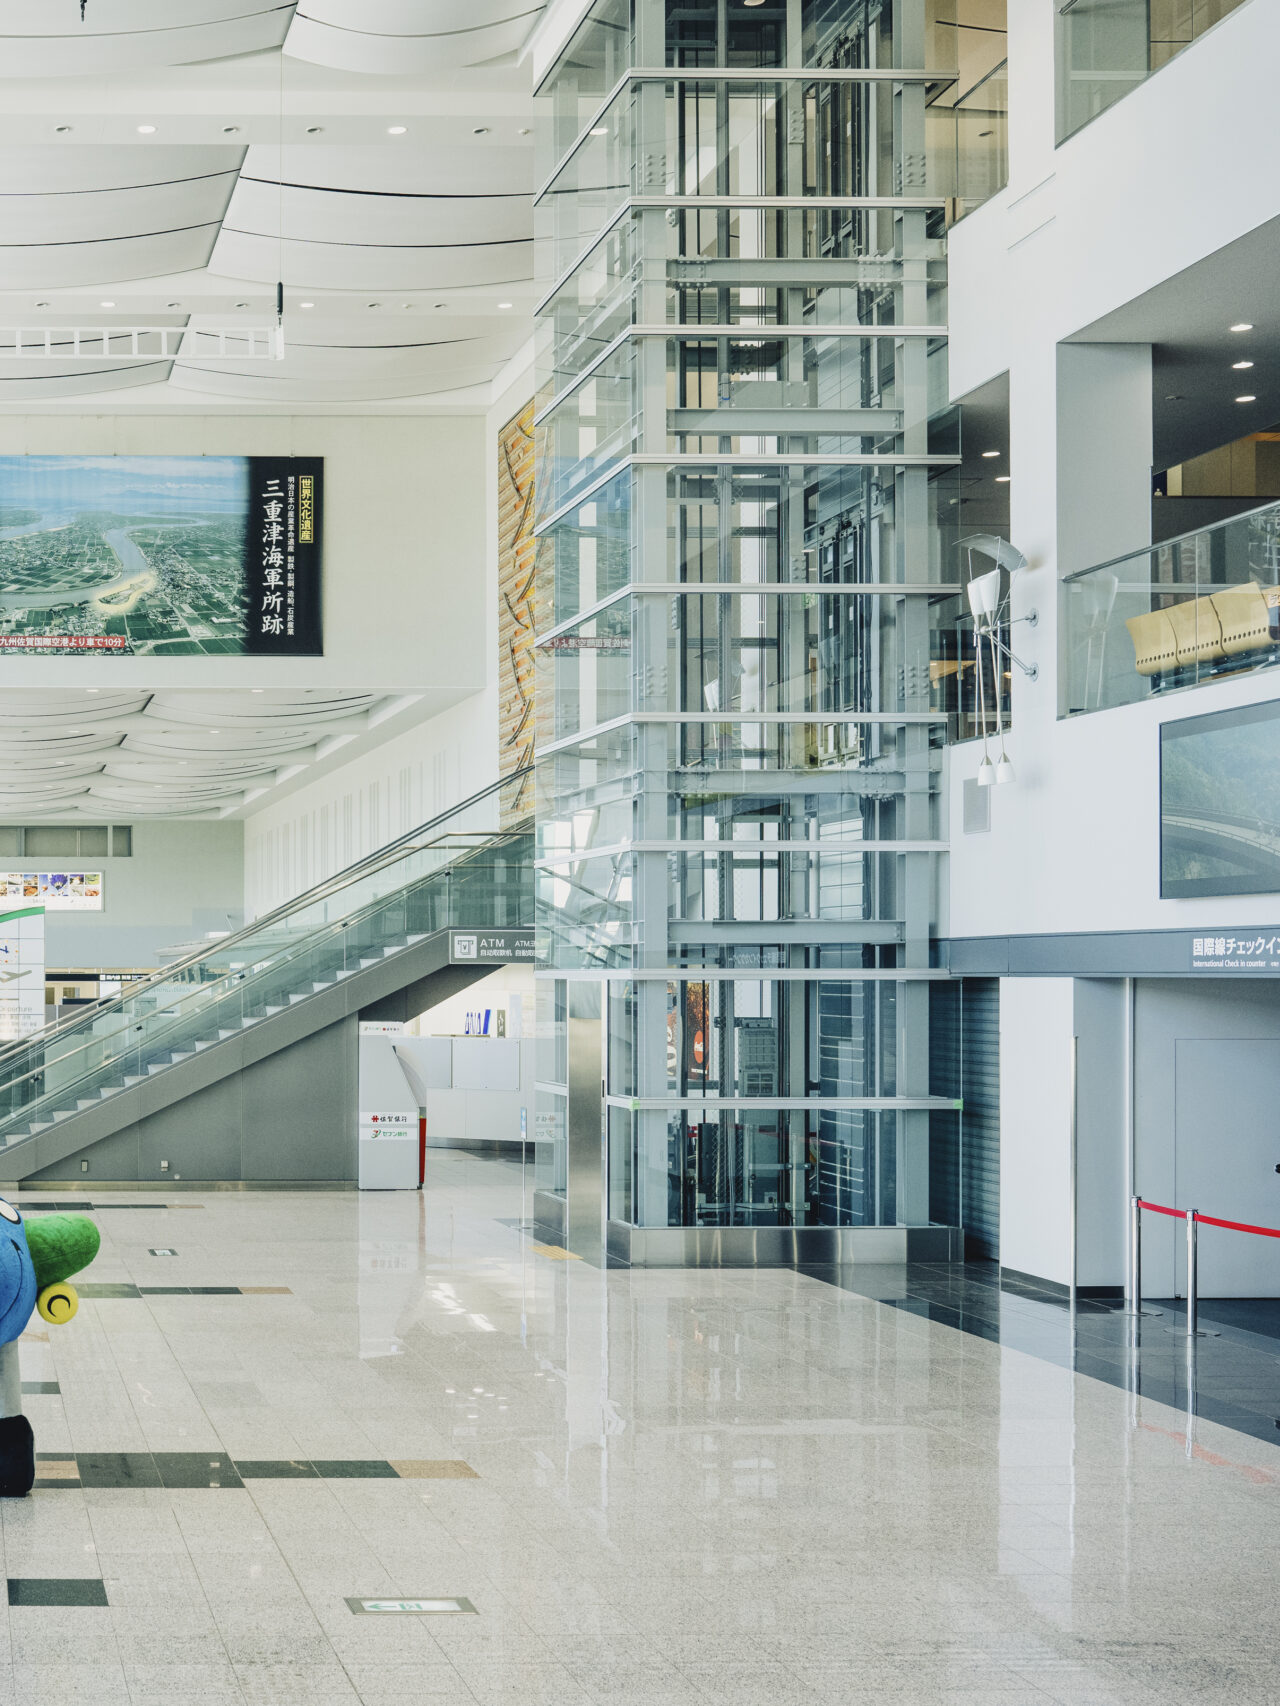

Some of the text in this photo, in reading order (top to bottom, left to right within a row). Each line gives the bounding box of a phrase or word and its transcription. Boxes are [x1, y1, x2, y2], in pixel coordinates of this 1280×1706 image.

[301, 478, 312, 541] 世界文化遺産
[261, 479, 285, 635] 三重津海軍所跡
[0, 636, 122, 647] 九州佐賀国際空港より車で10分
[480, 939, 505, 947] ATM
[1192, 960, 1224, 968] International
[1224, 959, 1240, 968] Check
